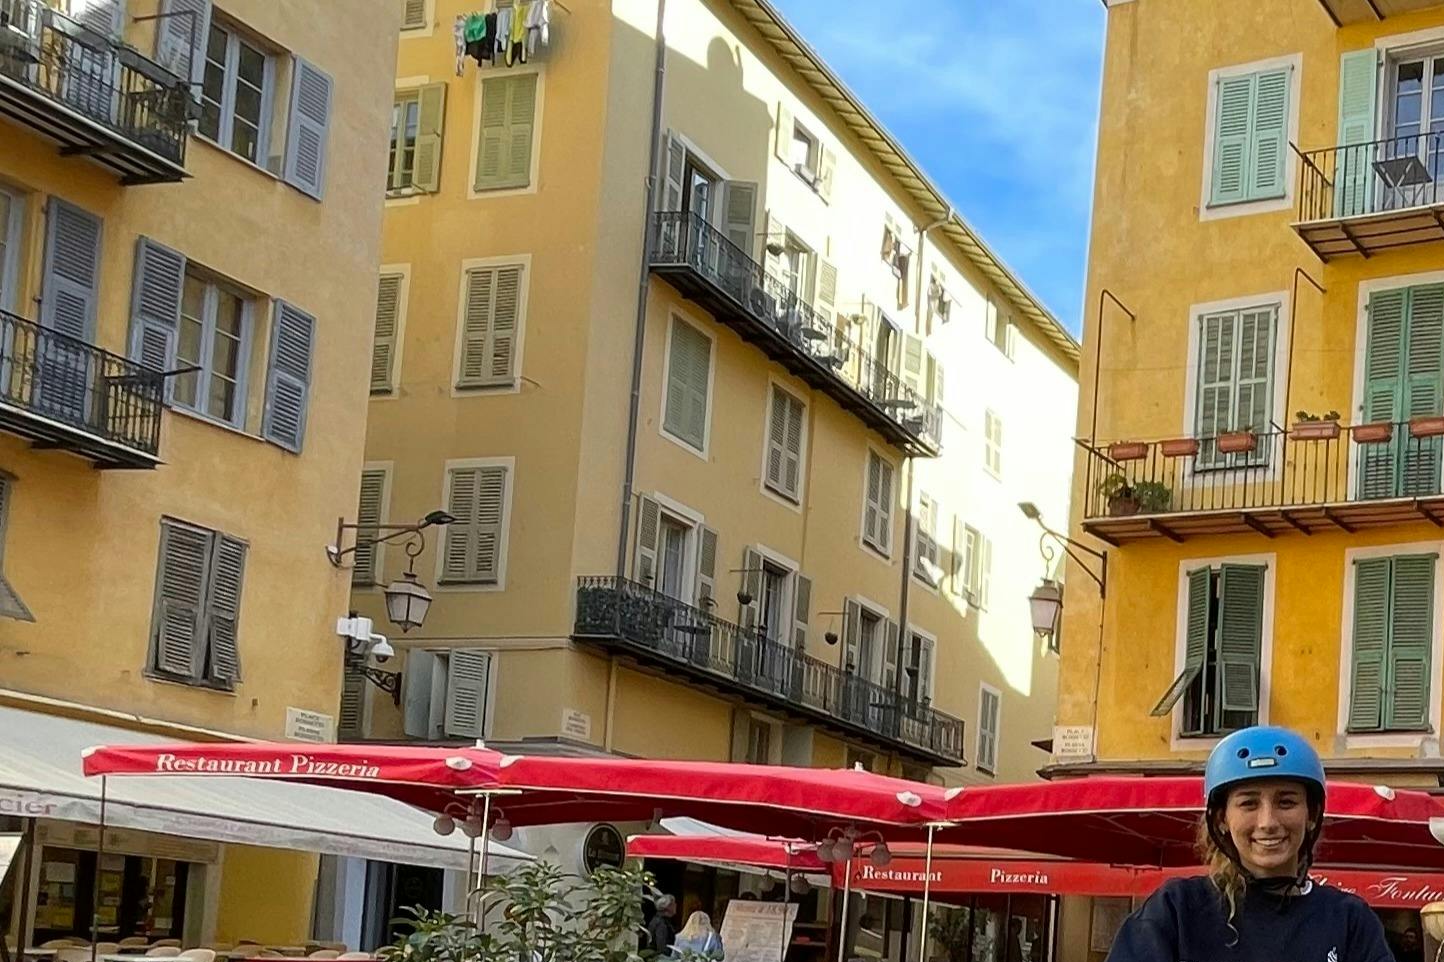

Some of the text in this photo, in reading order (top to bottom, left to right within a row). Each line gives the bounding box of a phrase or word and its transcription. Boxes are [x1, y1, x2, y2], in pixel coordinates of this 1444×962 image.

[155, 752, 381, 778] Restaurant Pizzeria
[862, 865, 1048, 885] Restaurant Pizzeria
